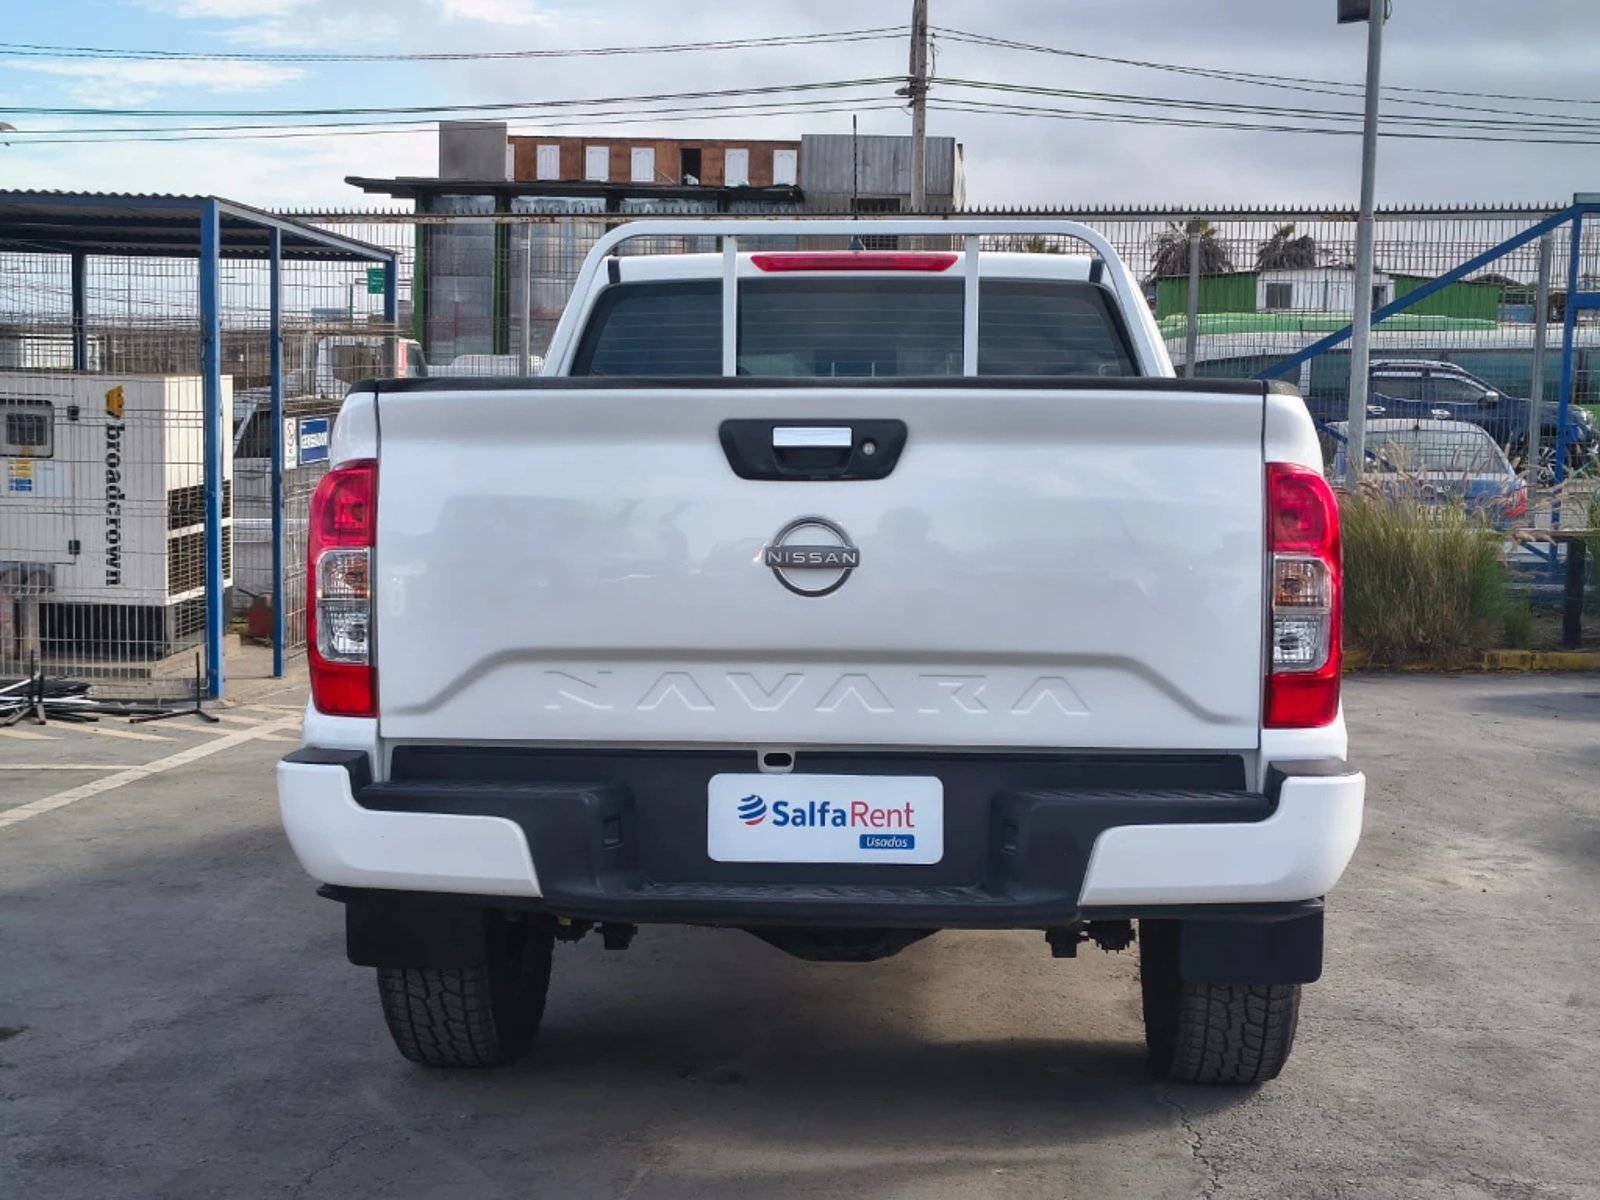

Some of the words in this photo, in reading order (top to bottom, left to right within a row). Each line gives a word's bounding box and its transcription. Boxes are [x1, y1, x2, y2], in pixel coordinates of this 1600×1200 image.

[105, 423, 125, 586] broadcrown
[767, 552, 857, 564] NISSAN
[544, 671, 1091, 715] NAVARA
[772, 800, 915, 828] SalfaRent
[866, 836, 908, 848] Usados
